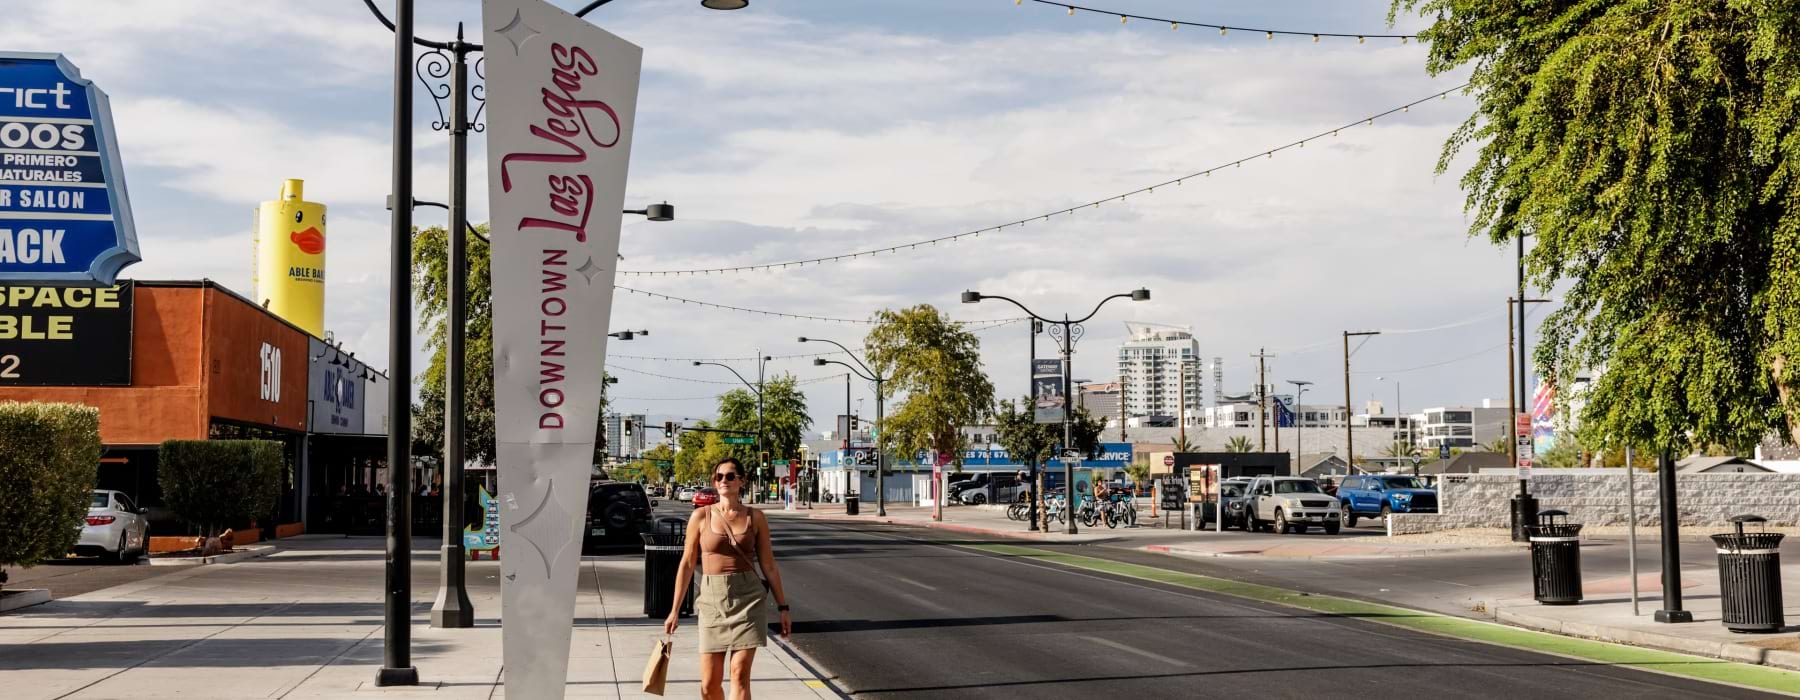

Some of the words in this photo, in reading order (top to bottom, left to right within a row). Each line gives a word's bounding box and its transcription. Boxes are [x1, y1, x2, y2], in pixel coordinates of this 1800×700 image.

[501, 43, 620, 193] Vegas
[3, 154, 78, 167] PRIMERO
[0, 169, 82, 182] ATURALES
[20, 189, 84, 209] SALON
[518, 175, 594, 243] Las
[0, 228, 66, 264] ACK
[289, 266, 310, 278] ABLE
[0, 315, 73, 340] BLE
[539, 249, 568, 429] DOWNTOWN
[0, 354, 20, 378] 2
[260, 342, 282, 403] 1510
